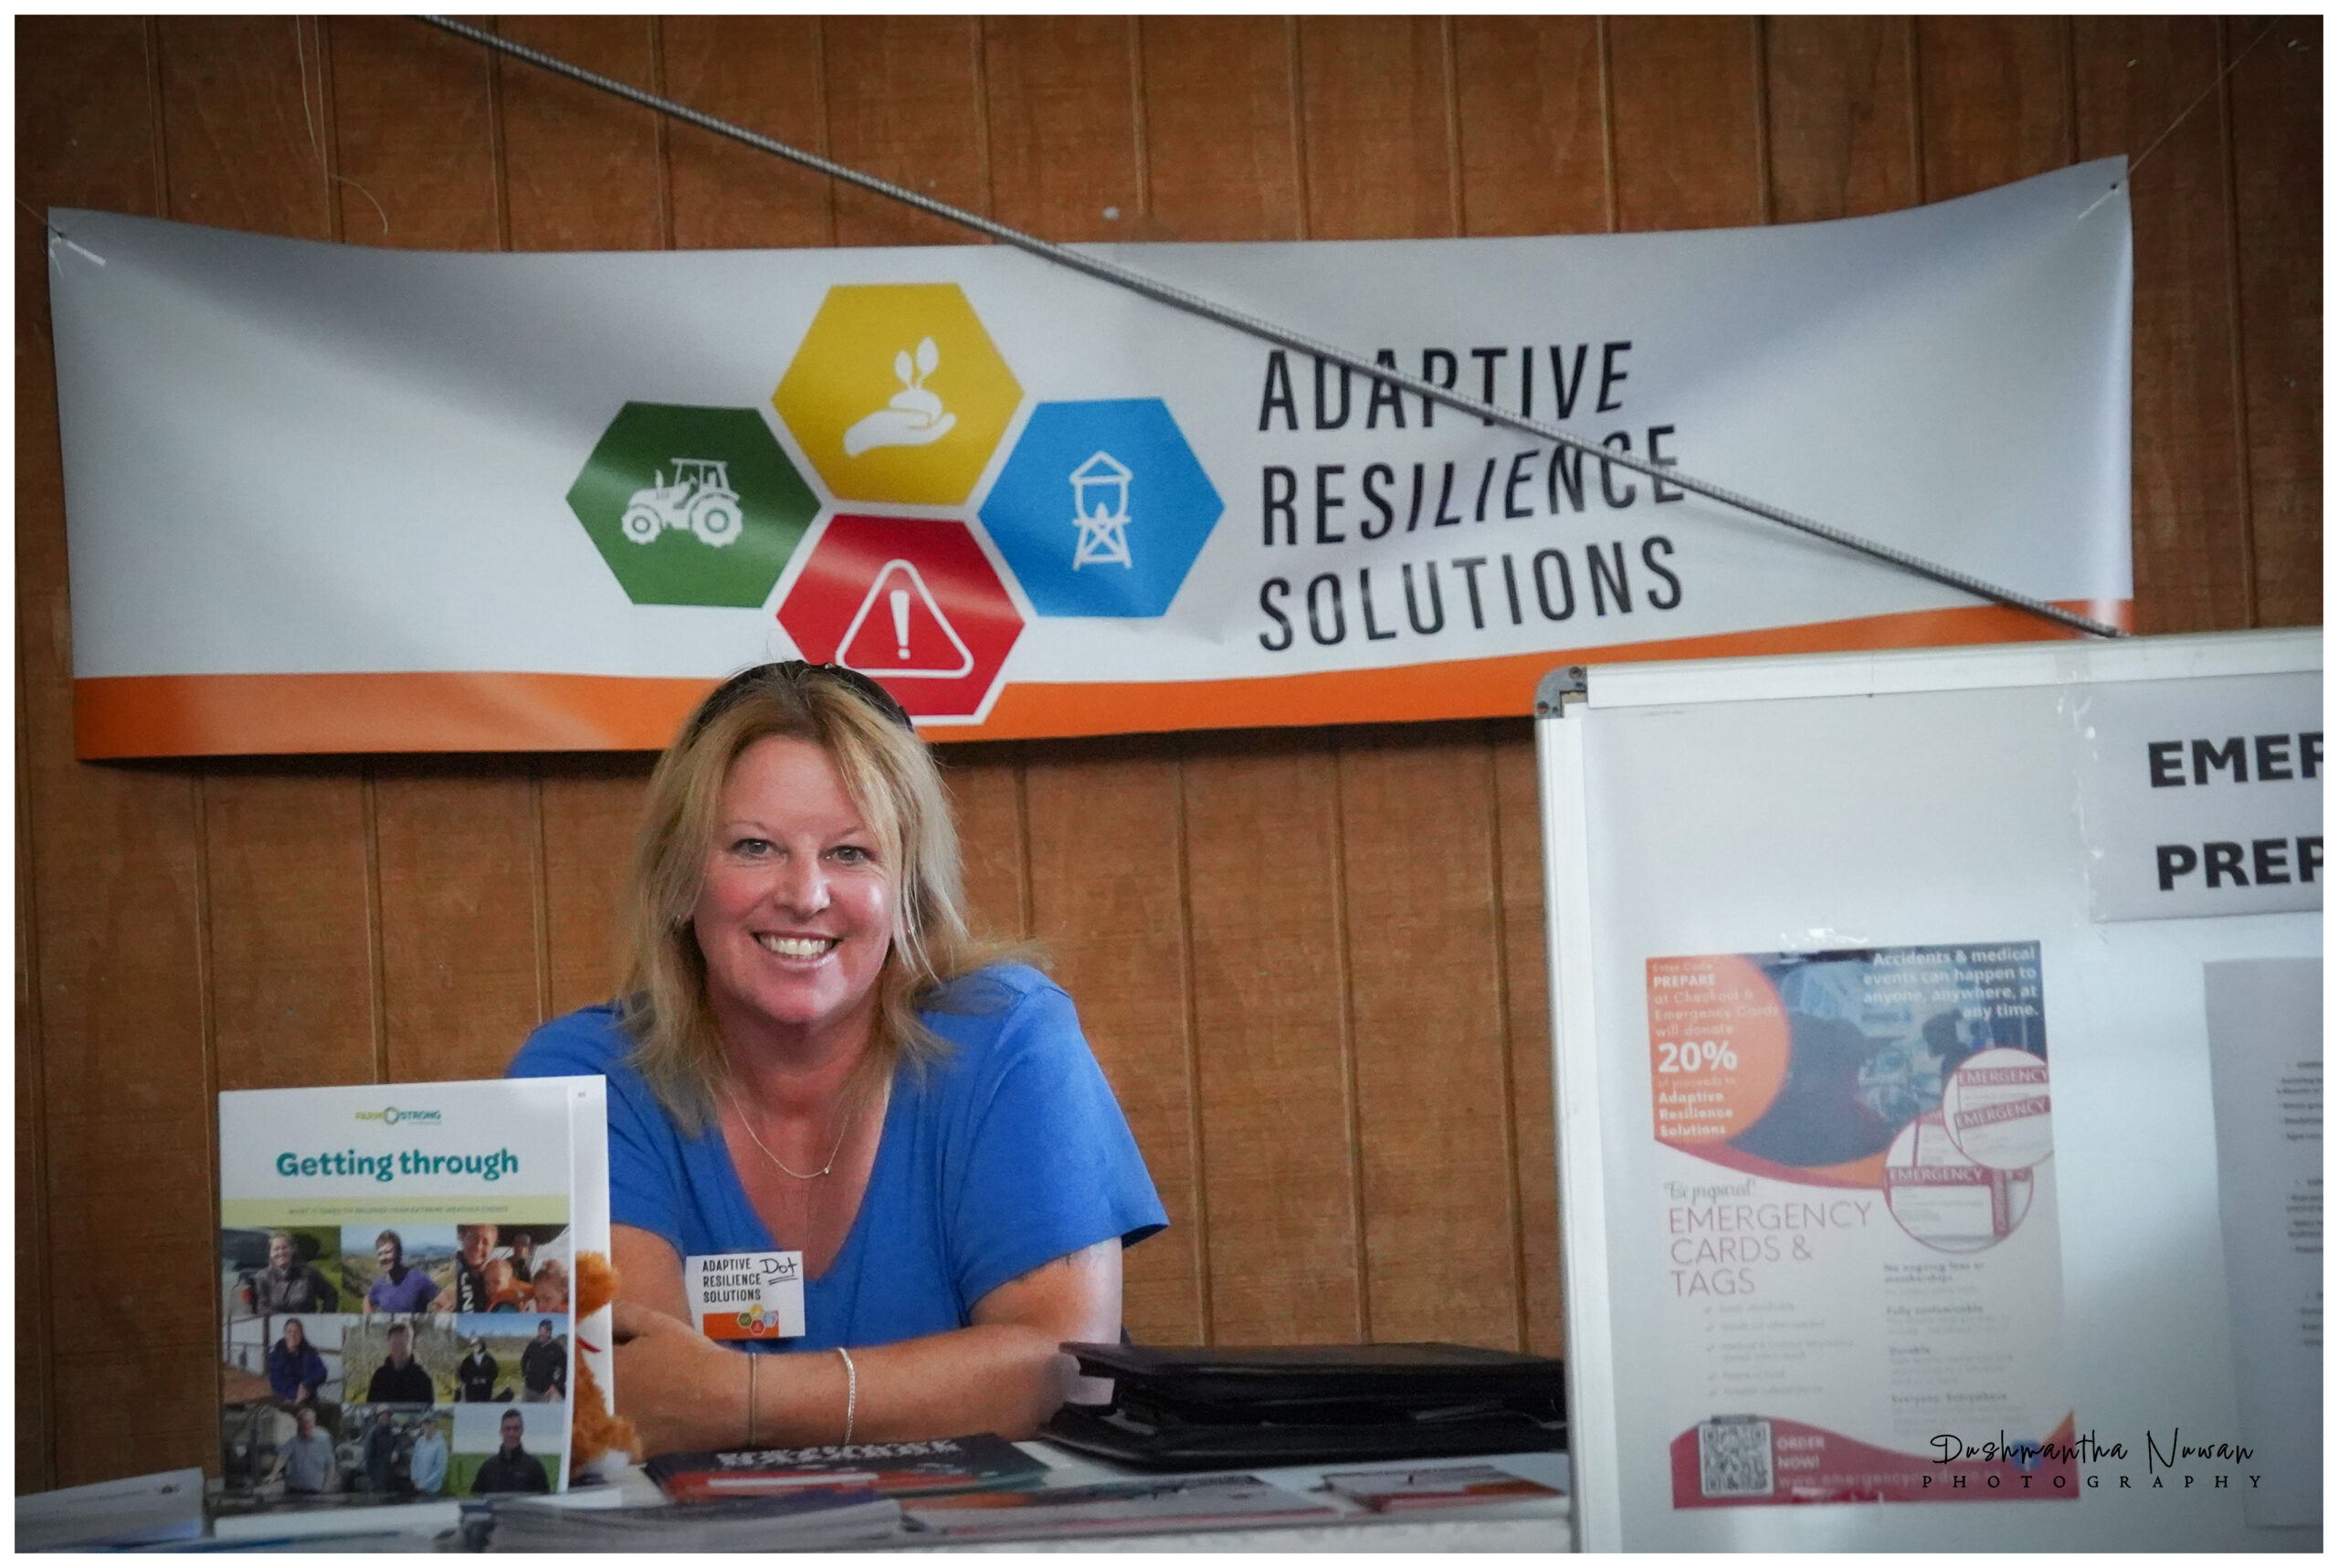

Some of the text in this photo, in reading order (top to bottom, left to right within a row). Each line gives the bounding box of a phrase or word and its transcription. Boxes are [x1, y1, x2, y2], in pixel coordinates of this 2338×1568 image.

[1259, 341, 1632, 431] ADAPTIVE
[1262, 426, 1685, 546] RESILIENCE
[1259, 536, 1682, 651] SOLUTIONS
[1873, 946, 2036, 966] Accidents & medical
[1652, 973, 1716, 988] PREPARE
[1863, 967, 2037, 985] events can happen to
[1673, 989, 1739, 1004] Checkout
[2020, 985, 2038, 999] at
[1654, 1008, 1732, 1024] Emergency
[1962, 1003, 2039, 1022] any time.
[1656, 1023, 1734, 1037] will donate
[1658, 1039, 1738, 1073] 20%
[1659, 1090, 1724, 1106] Adaptive
[1659, 1107, 1733, 1121] Resilience
[1956, 1099, 2046, 1129] EMERGENCY
[1659, 1123, 1726, 1138] Solutions
[276, 1147, 520, 1183] Getting through
[1890, 1167, 1984, 1181] EMERGENCY
[1669, 1200, 1871, 1234] EMERGENCY
[1670, 1234, 1813, 1266] CARDS &
[702, 1258, 752, 1272] ADAPTIVE
[760, 1257, 797, 1275] Dot
[702, 1273, 762, 1288] RESILIENCE
[1670, 1268, 1755, 1298] TAGS
[702, 1289, 762, 1303] SOLUTIONS
[1776, 1436, 1826, 1450] ORDER
